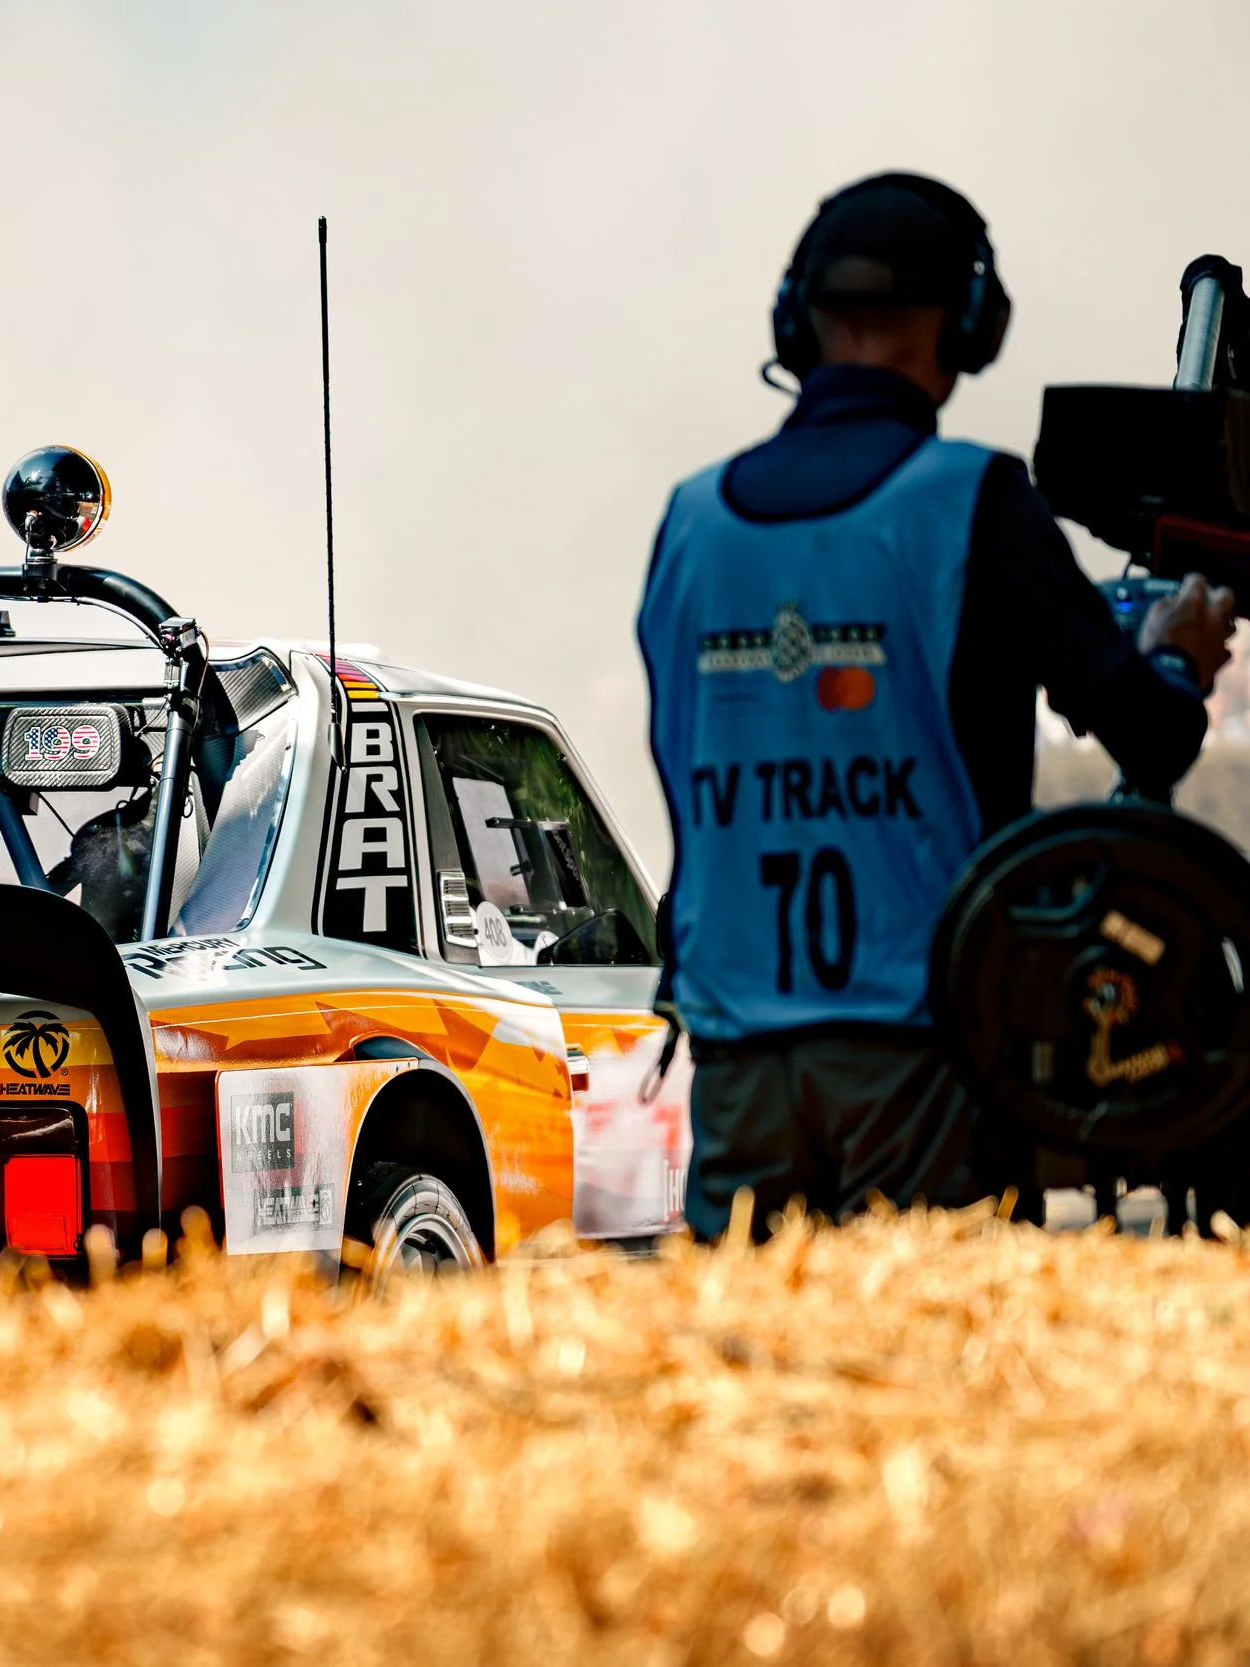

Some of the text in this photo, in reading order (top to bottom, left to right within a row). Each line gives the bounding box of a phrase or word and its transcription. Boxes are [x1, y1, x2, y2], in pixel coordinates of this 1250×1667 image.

[24, 725, 100, 762] 199
[755, 755, 922, 825] TRACK
[336, 722, 407, 933] BRAT
[138, 937, 240, 957] MERCURY
[759, 846, 858, 995] 70
[0, 1083, 71, 1096] HEATWAVE
